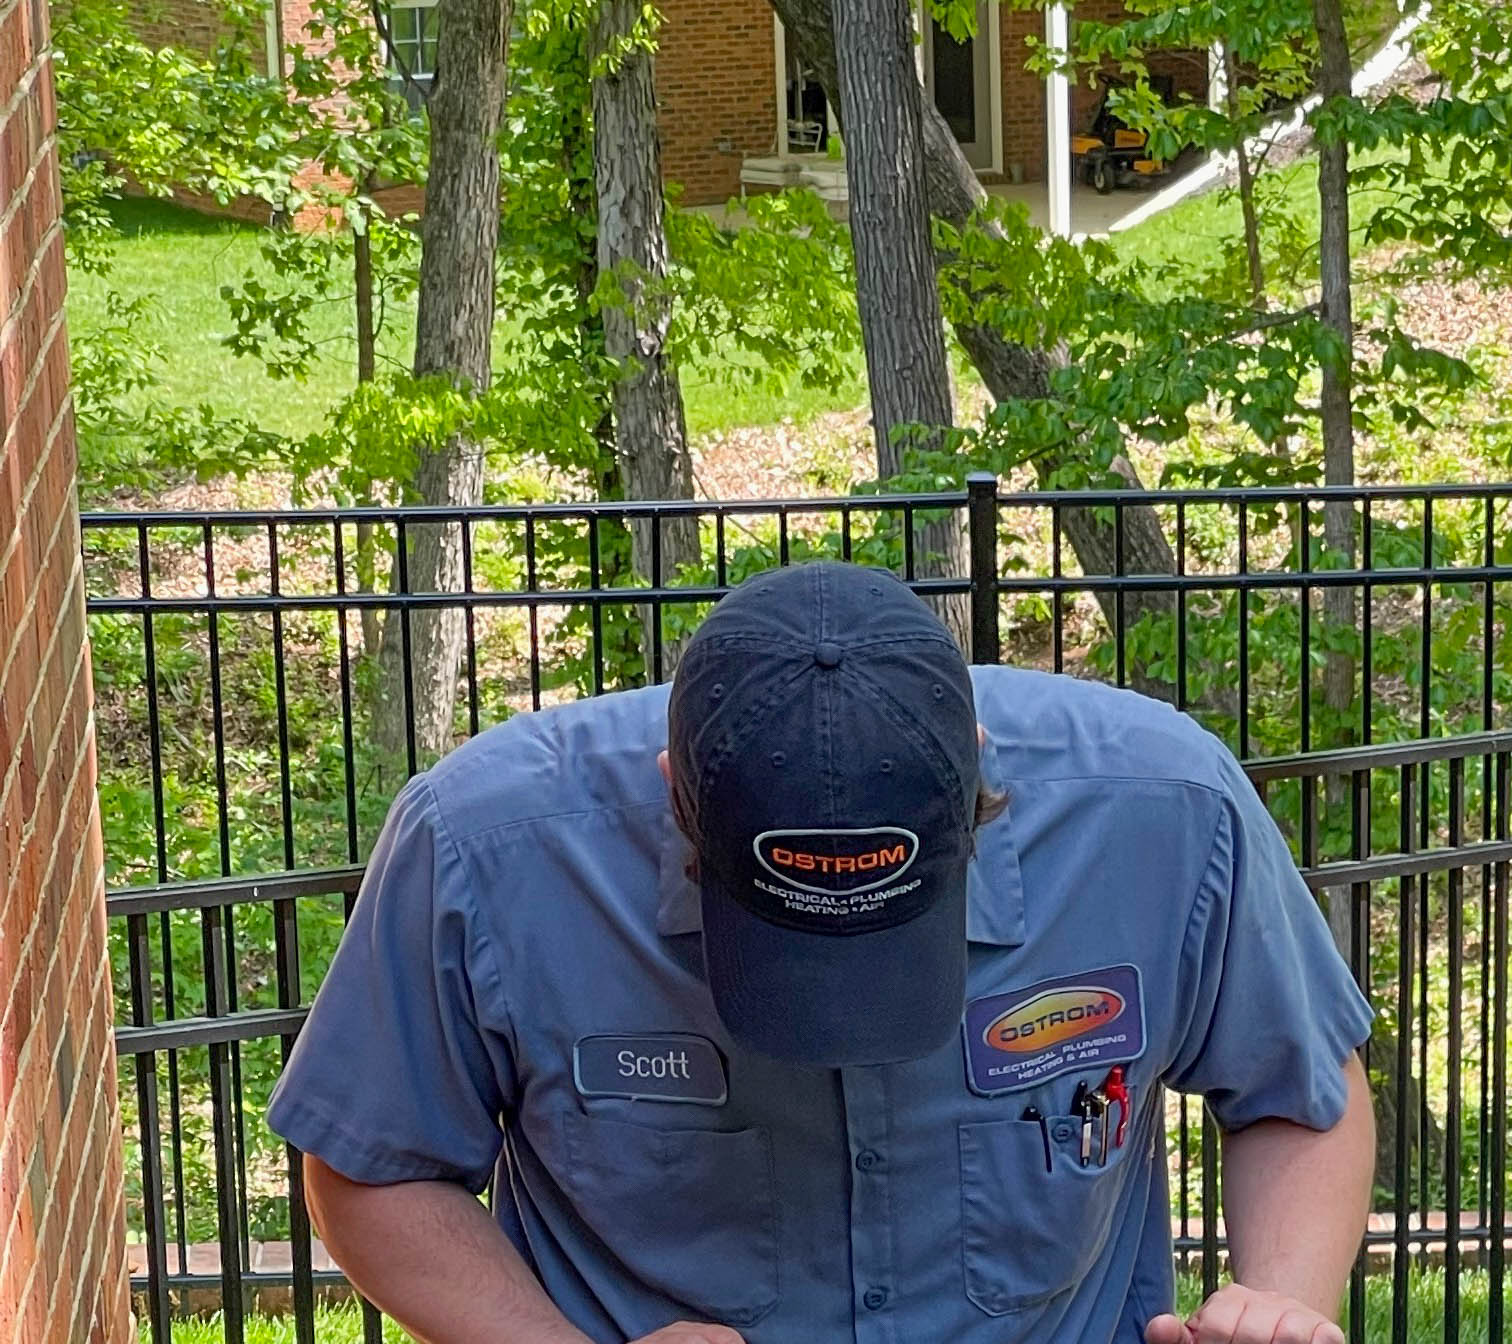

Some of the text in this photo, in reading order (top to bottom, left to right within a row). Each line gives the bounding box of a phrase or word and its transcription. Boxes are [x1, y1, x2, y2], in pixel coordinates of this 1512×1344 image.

[772, 845, 906, 873] OSTROM
[753, 878, 922, 906] ELECTRICAL PLUMBING
[784, 899, 885, 915] HEATING AIR
[1000, 1000, 1110, 1042] OSTROM
[617, 1050, 691, 1079] Scott
[988, 1033, 1127, 1076] ELECTRICAL PLUMBING
[1017, 1049, 1100, 1079] HEATING & AIR
